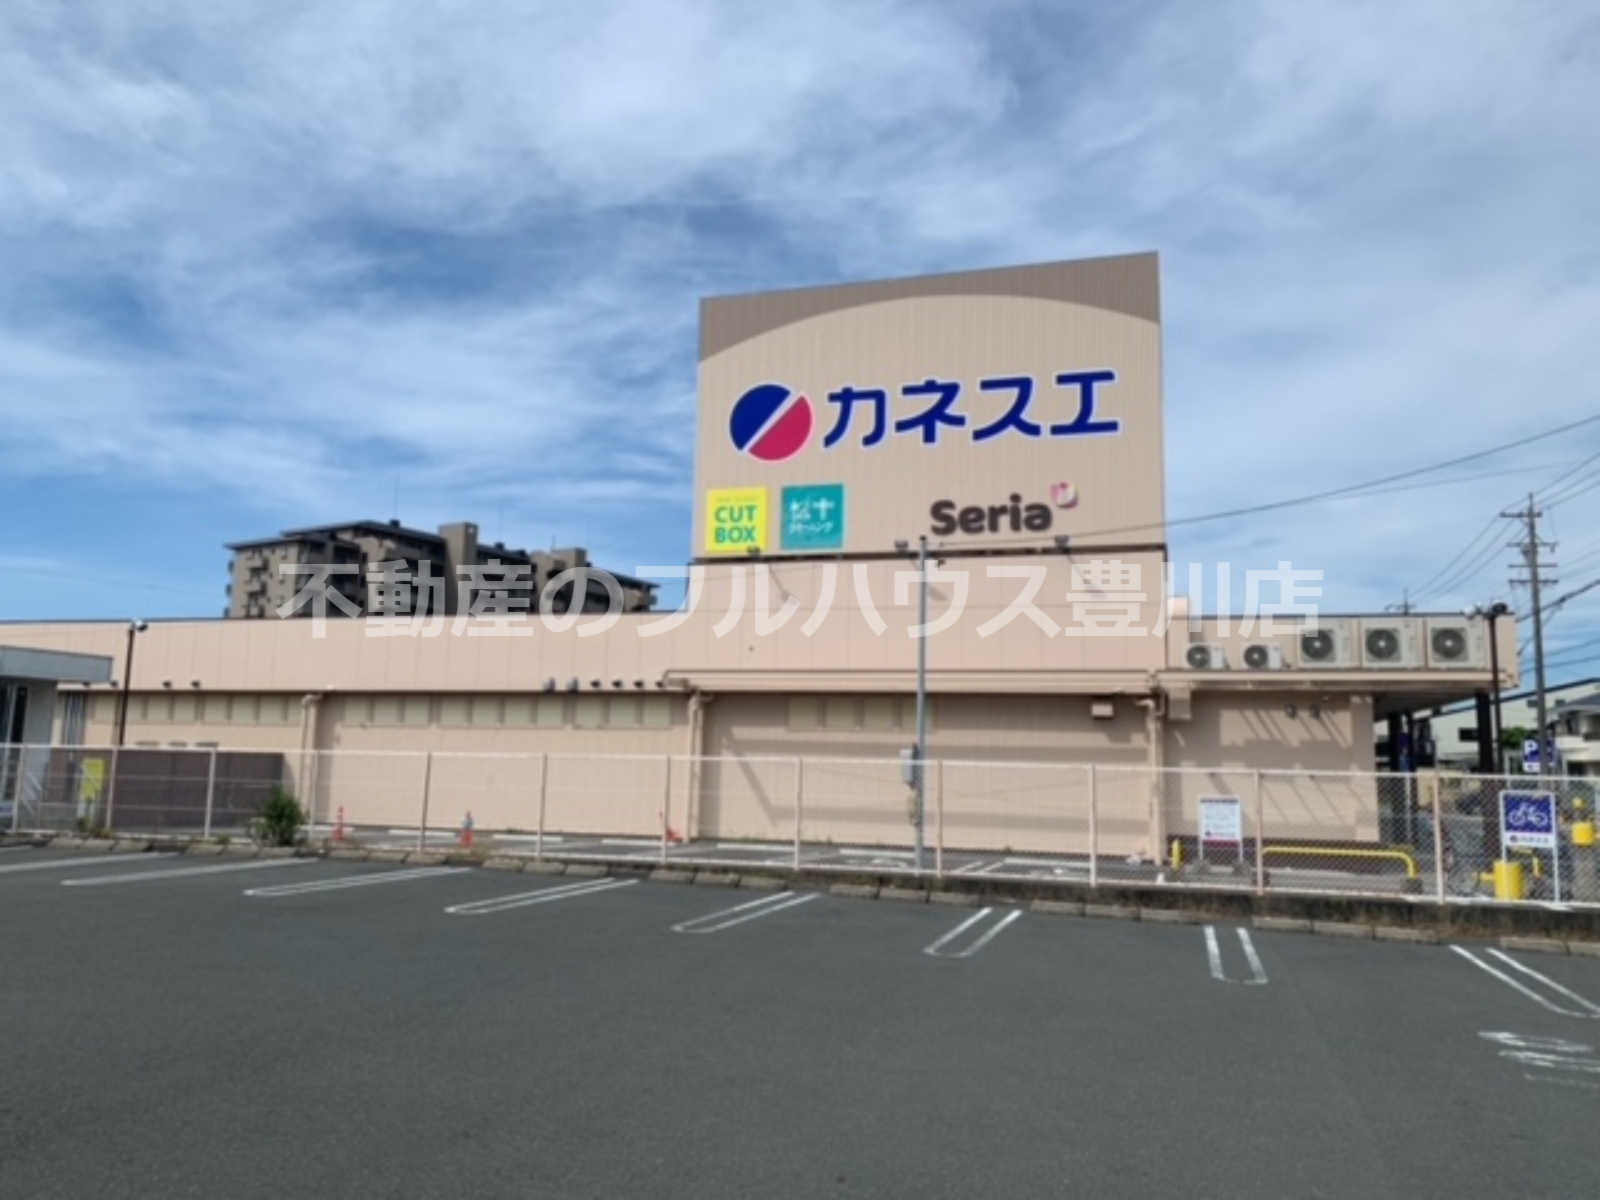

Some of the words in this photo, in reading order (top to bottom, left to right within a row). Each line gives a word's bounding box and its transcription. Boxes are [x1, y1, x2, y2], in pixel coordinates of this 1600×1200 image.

[822, 369, 1120, 449] カネスエ
[714, 504, 758, 523] CUT
[930, 492, 1053, 536] Seria
[714, 526, 756, 543] BOX
[1524, 740, 1539, 757] P
